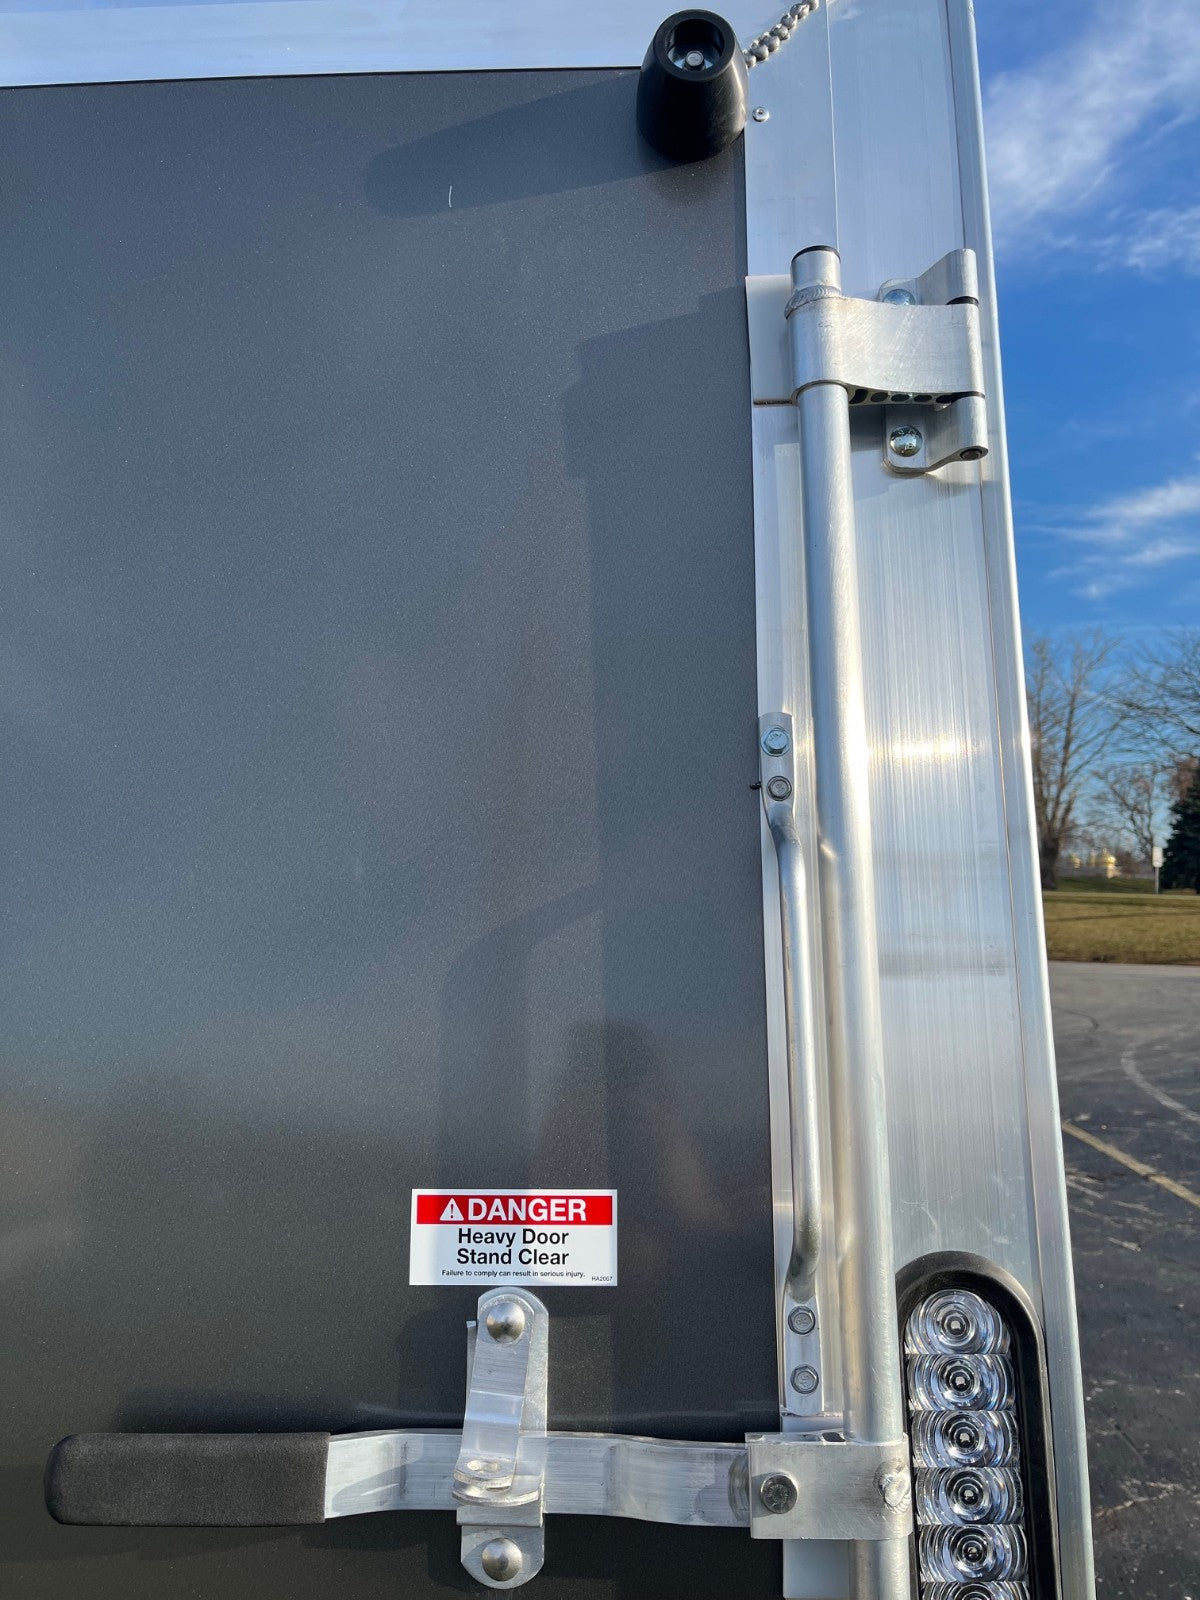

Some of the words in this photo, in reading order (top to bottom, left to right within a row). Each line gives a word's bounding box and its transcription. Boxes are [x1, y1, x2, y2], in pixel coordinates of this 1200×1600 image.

[468, 1198, 587, 1221] DANGER
[458, 1228, 516, 1247] Heavy
[523, 1229, 569, 1244] Door
[456, 1249, 512, 1264] Stand
[518, 1249, 569, 1265] Clear
[566, 1271, 585, 1279] injury.
